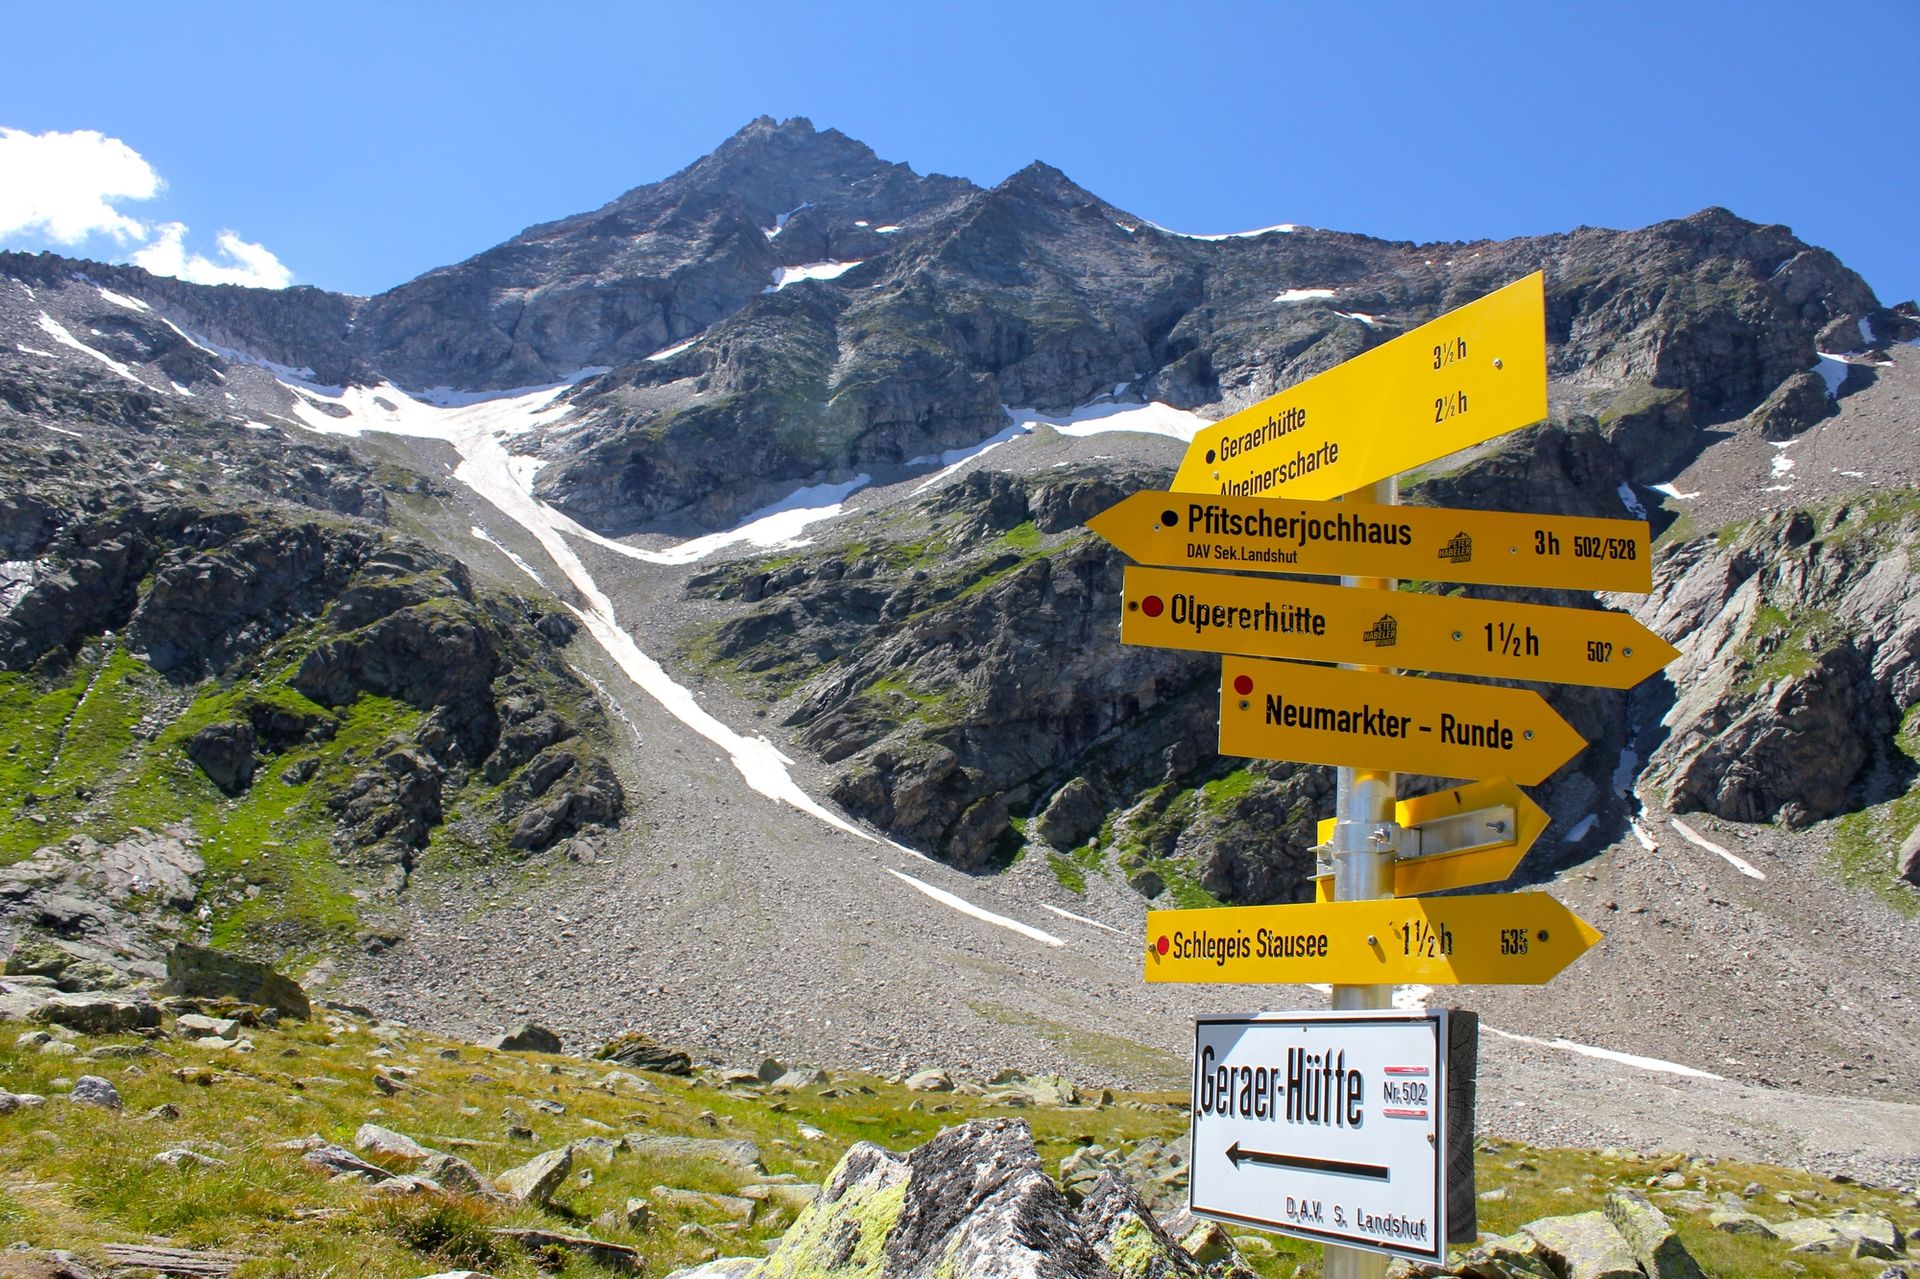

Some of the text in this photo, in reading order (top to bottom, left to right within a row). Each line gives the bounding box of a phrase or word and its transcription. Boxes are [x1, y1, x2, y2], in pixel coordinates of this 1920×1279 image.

[1220, 408, 1306, 462] Geraerhütte
[1188, 503, 1412, 548] Pfitscherjochhaus
[1187, 543, 1211, 559] DAV
[1574, 536, 1637, 561] 502/528
[1171, 593, 1326, 637] Olpererhütte
[1373, 622, 1396, 631] PETER
[1363, 630, 1396, 641] HABELER
[1587, 641, 1613, 663] 502
[1266, 694, 1411, 739] Neumarkter
[1440, 713, 1514, 750] Runde
[1173, 928, 1328, 967] Schlegeis Stausee
[1501, 928, 1528, 955] 535
[1200, 1045, 1363, 1125] Geraer-Hütte
[1286, 1196, 1426, 1238] D.A.V. S. Landshut
